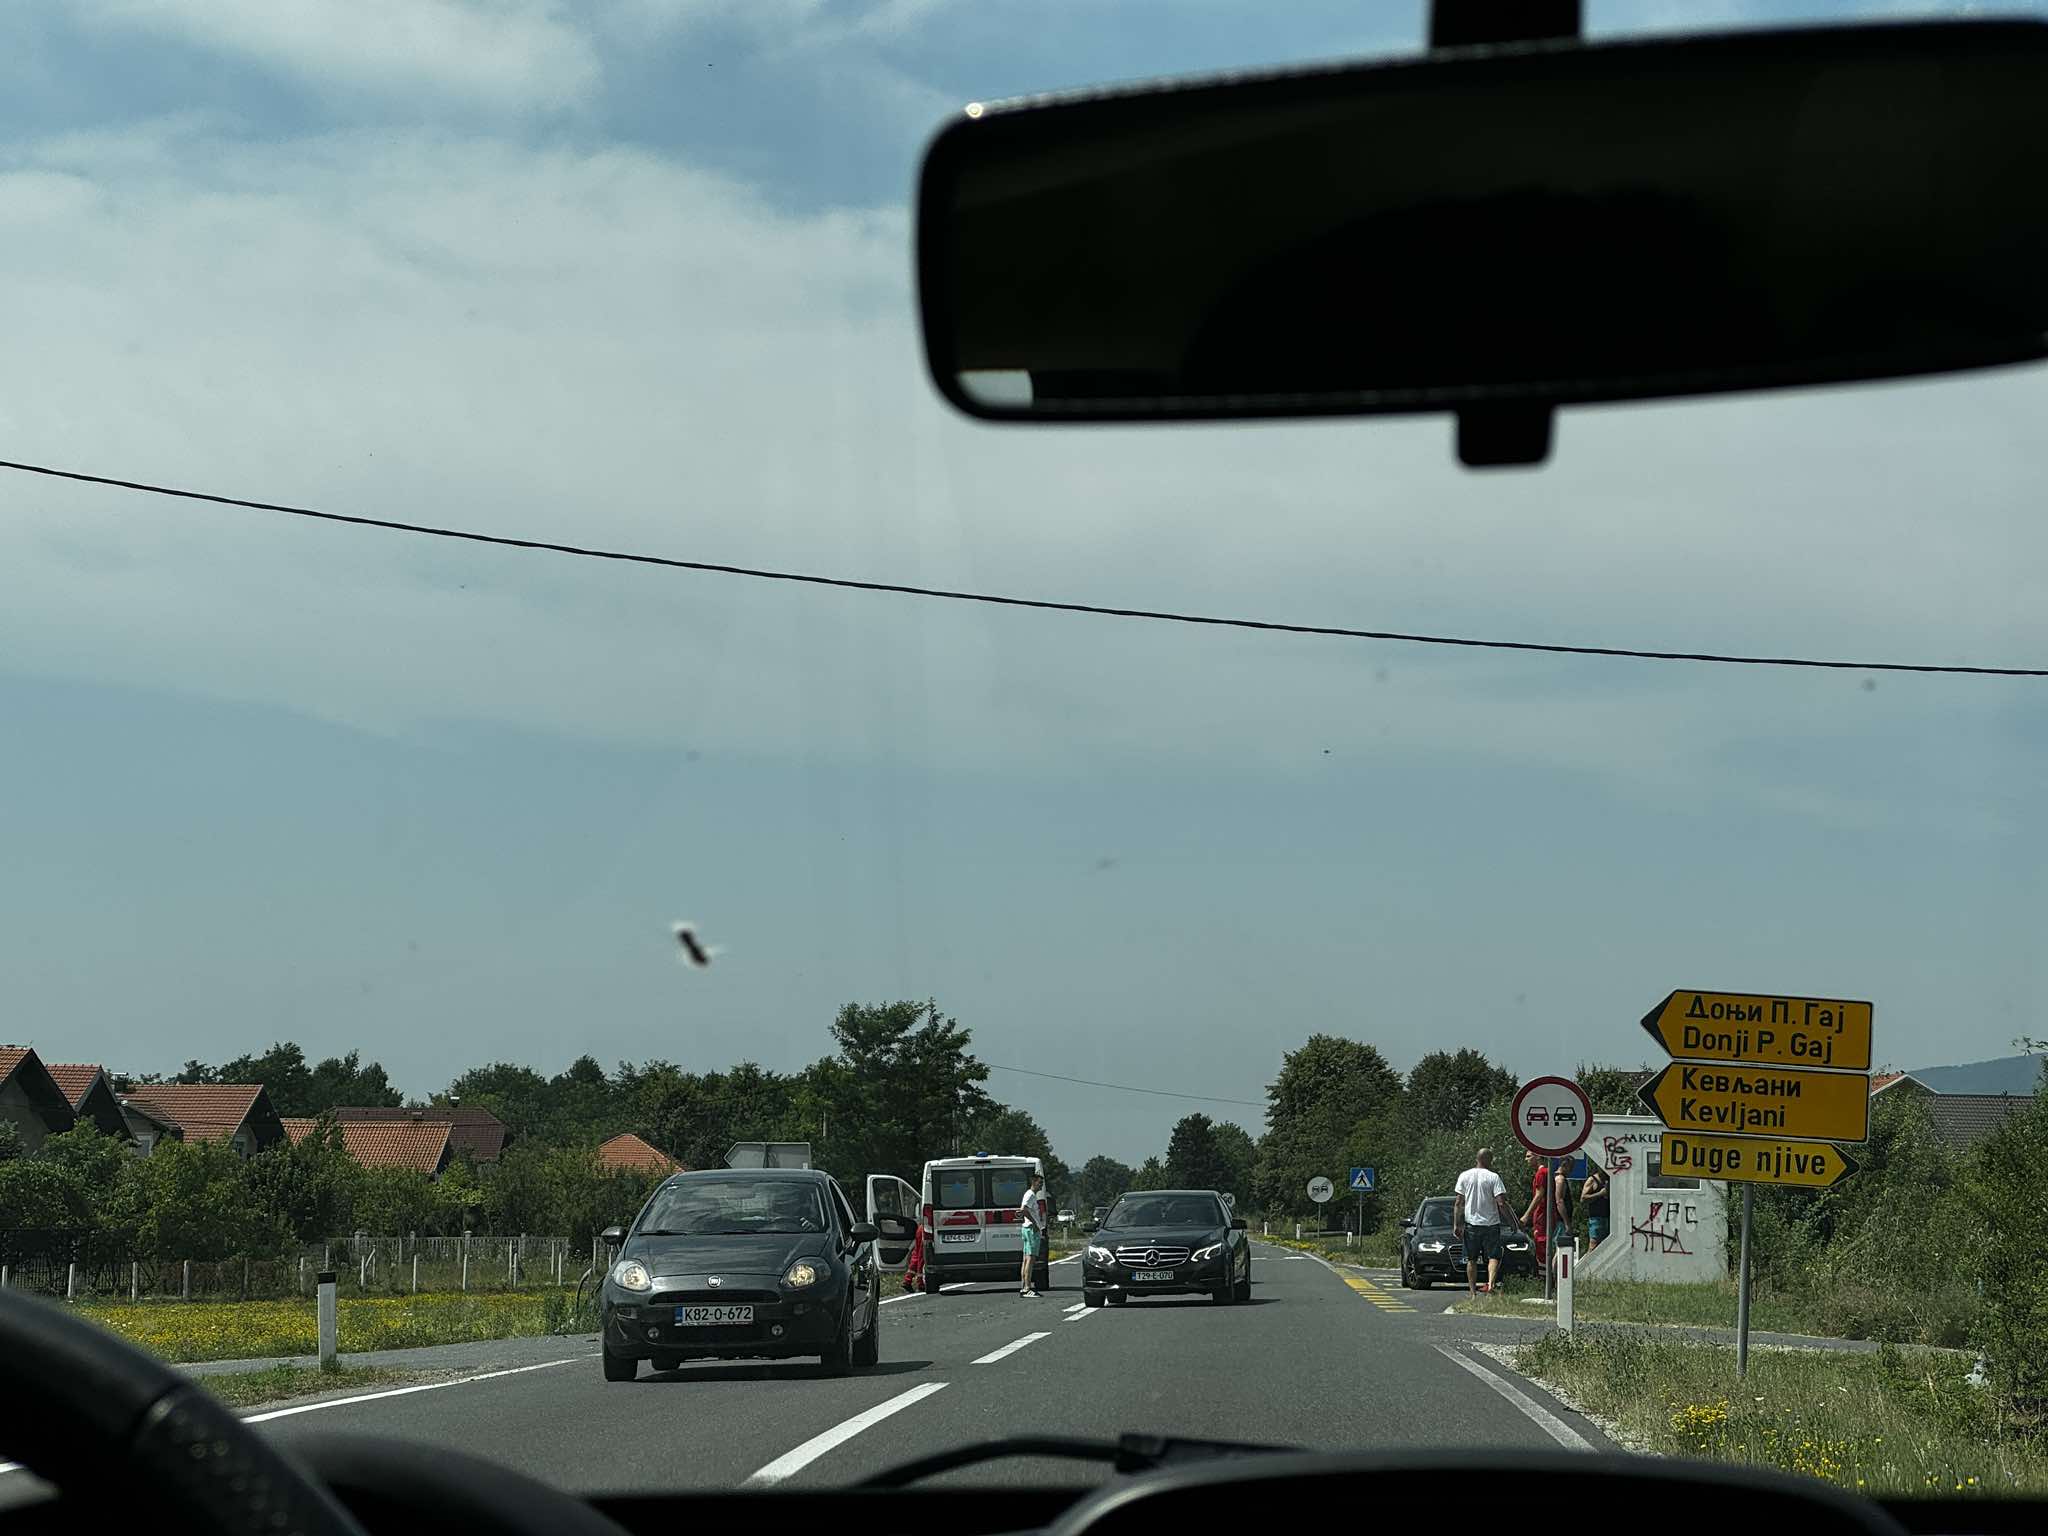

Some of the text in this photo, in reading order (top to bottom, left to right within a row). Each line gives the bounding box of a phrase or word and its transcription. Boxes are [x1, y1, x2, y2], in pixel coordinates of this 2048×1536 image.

[1685, 995, 1762, 1023] Доњи
[1683, 1026, 1749, 1058] Donji
[1790, 1033, 1833, 1064] Gaj
[1681, 1067, 1801, 1098] Кевљани
[1680, 1098, 1785, 1131] Kevljani
[1671, 1139, 1742, 1173] Duge
[1757, 1146, 1826, 1178] njive
